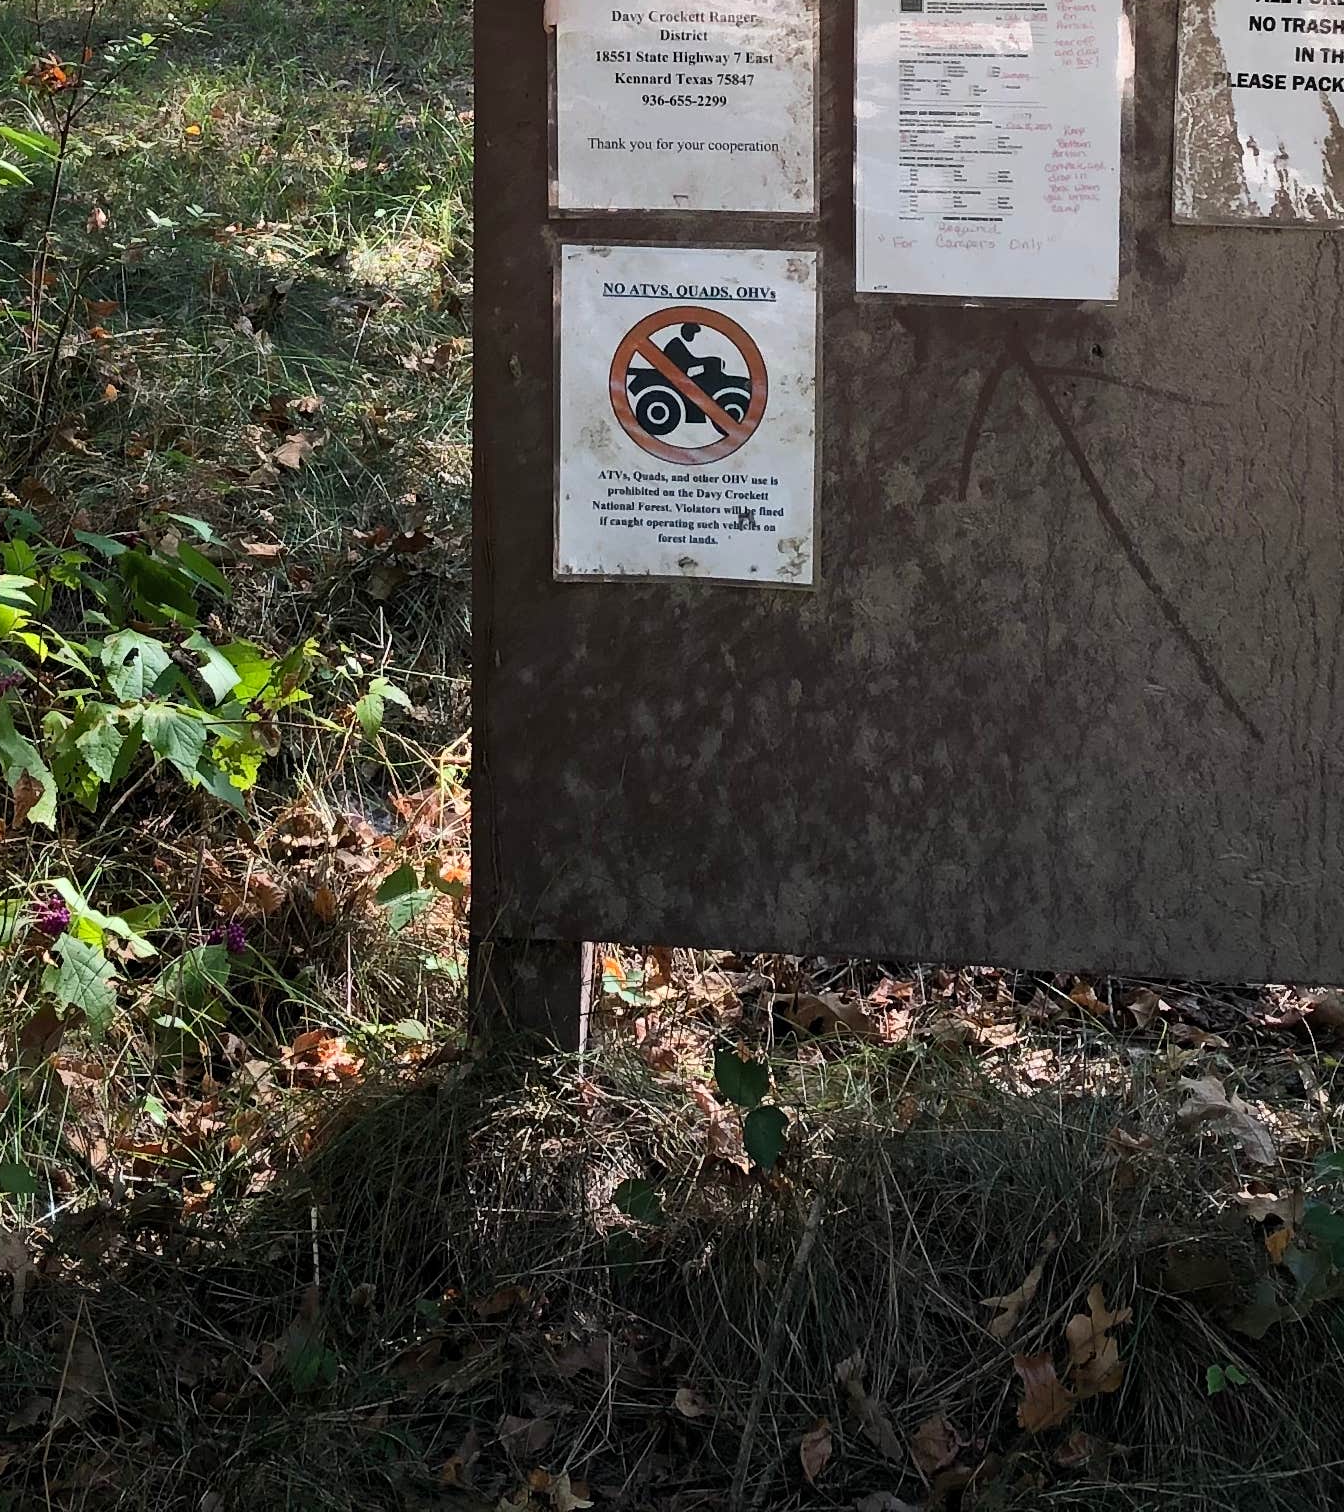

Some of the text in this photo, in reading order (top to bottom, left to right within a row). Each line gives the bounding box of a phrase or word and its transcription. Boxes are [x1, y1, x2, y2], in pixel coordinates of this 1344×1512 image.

[611, 10, 755, 27] Davy Crockett Ranger
[1249, 16, 1276, 32] NO
[1281, 17, 1344, 35] TRASH
[660, 29, 708, 41] District
[596, 51, 774, 67] 18551 State Highway 7 East
[1295, 46, 1315, 62] IN
[614, 72, 755, 86] Kennard Texas 75847
[1292, 75, 1344, 93] PACK
[641, 94, 727, 107] 936-655-2299
[587, 138, 780, 153] Thank you for your cooperation
[603, 283, 626, 295] NO
[676, 285, 733, 299] QUADS,
[736, 286, 777, 300] OHVs
[598, 470, 778, 486] ATVs, Quads, and other OHV use is
[607, 486, 769, 501] prohibited on the Davy Crockett
[592, 500, 784, 517] National Forest. Violators will be fined
[599, 517, 776, 532] if caught operating such vehicles on
[658, 533, 718, 545] forest lands.
